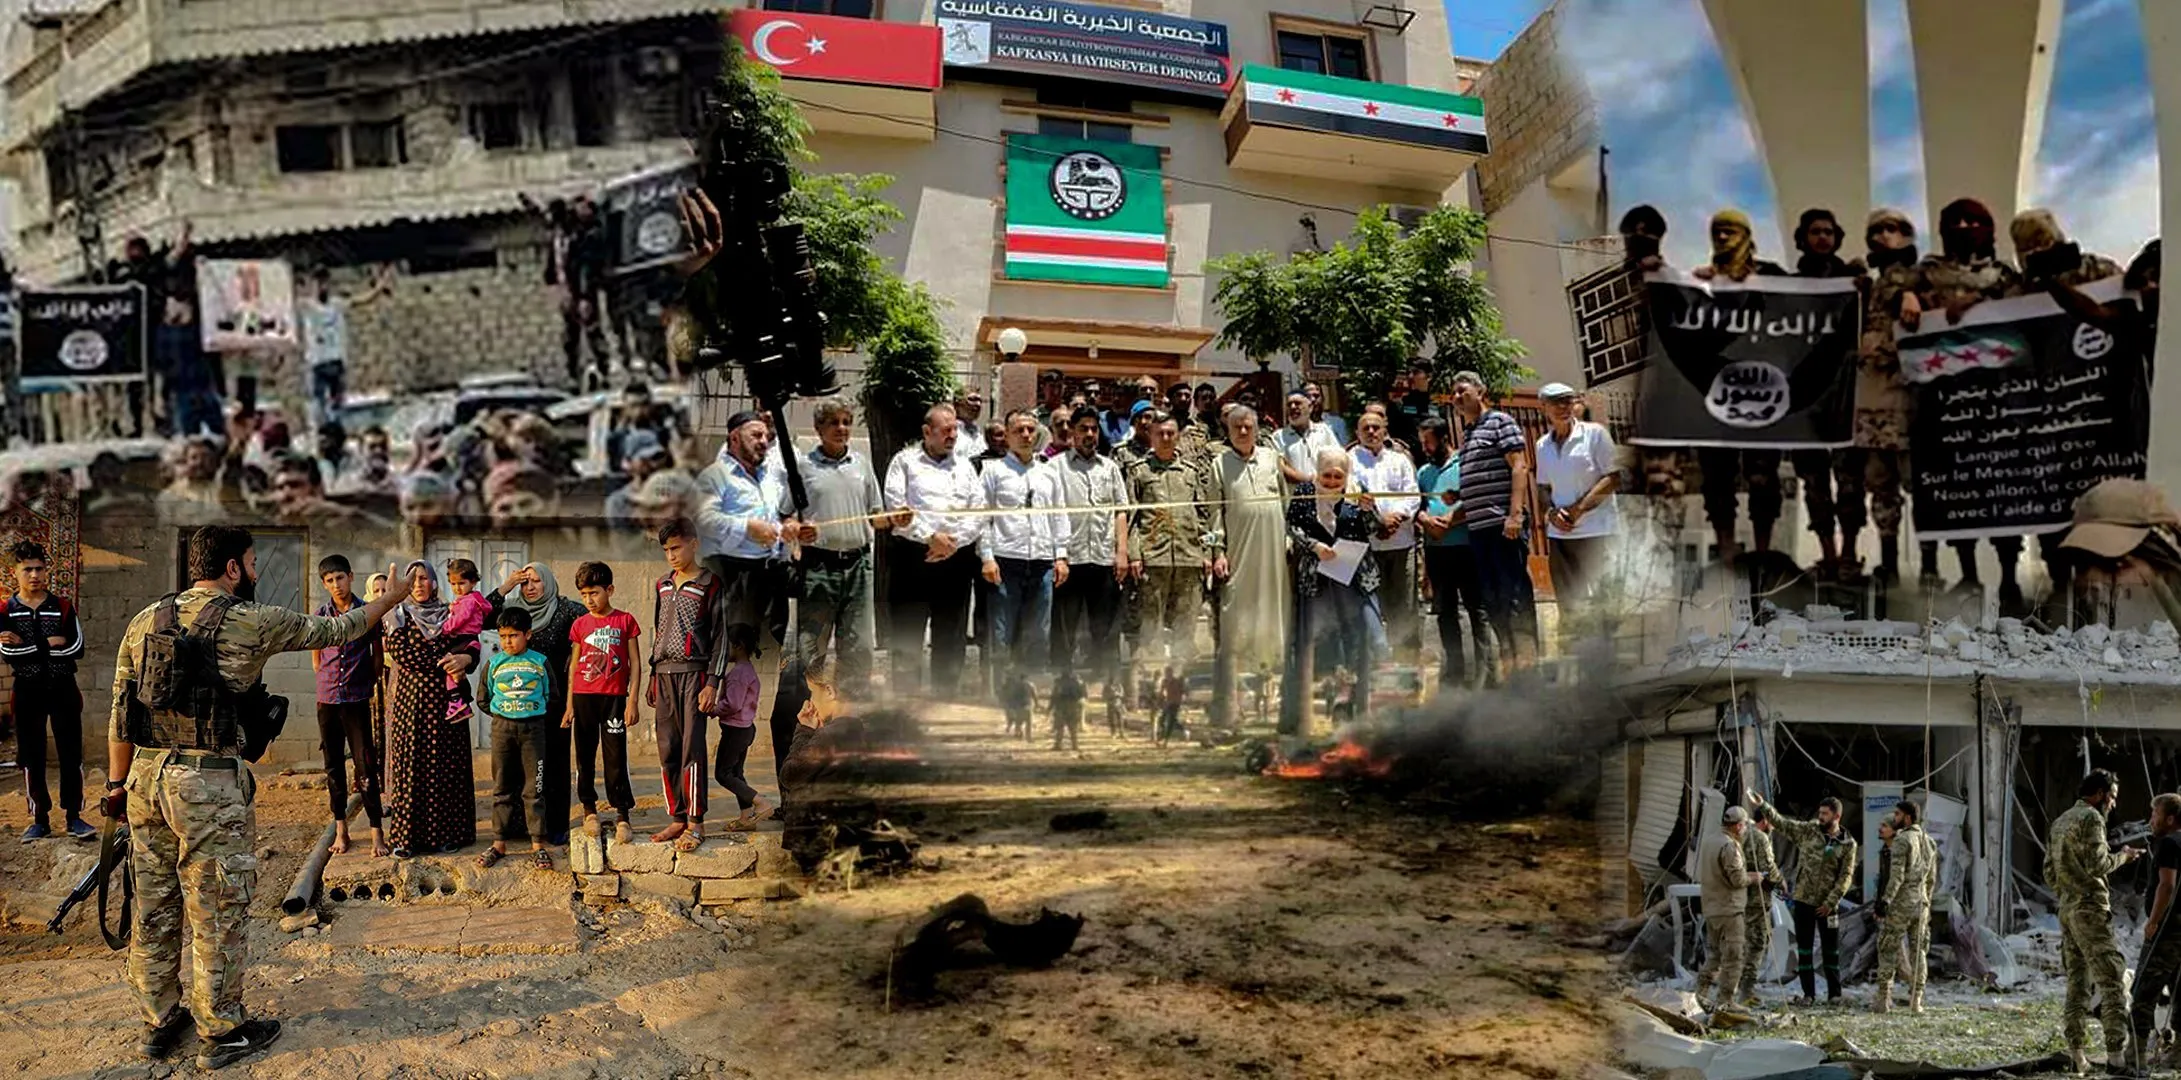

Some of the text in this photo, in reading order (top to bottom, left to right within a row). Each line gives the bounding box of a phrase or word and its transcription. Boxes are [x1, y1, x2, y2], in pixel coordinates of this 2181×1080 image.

[941, 0, 1220, 47] الجمعية الخيرية القفقاسية
[997, 45, 1069, 63] KAFKASYA
[1072, 54, 1159, 75] HAYIRSEVER
[1713, 387, 1784, 406] رسول
[1955, 439, 2096, 464] Langue qui ose
[1921, 471, 1948, 486] Sur
[1953, 469, 1970, 482] le
[1975, 460, 2064, 479] Messager
[1933, 489, 1980, 502] Nous
[1985, 483, 2038, 499] allons
[2042, 480, 2060, 494] le
[1947, 507, 1988, 520] avec
[1993, 501, 2046, 518] l'aide
